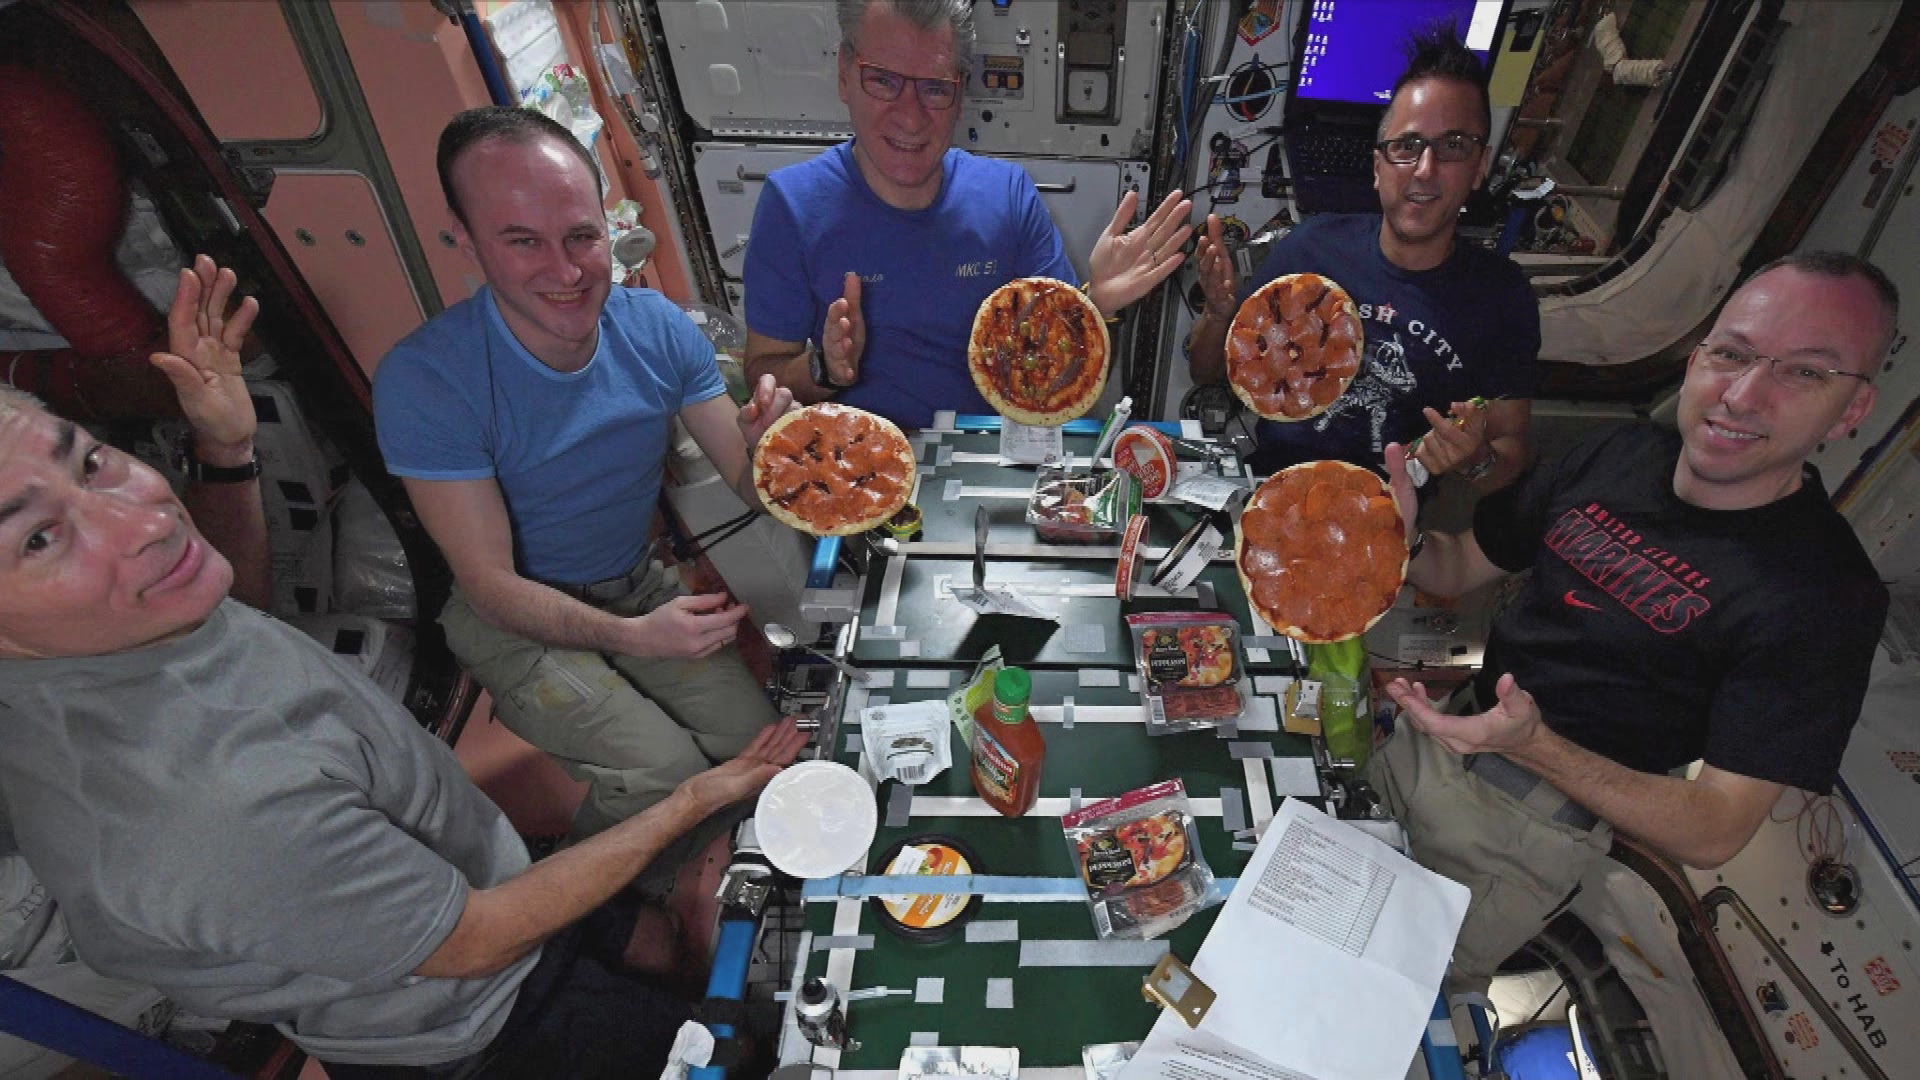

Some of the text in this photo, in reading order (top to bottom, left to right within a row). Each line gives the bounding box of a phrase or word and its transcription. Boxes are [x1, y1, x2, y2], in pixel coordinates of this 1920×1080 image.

[1408, 319, 1463, 371] CITY
[1544, 507, 1711, 634] MARINES
[1585, 502, 1711, 588] UNITED STATES
[1847, 993, 1887, 1049] HAB
